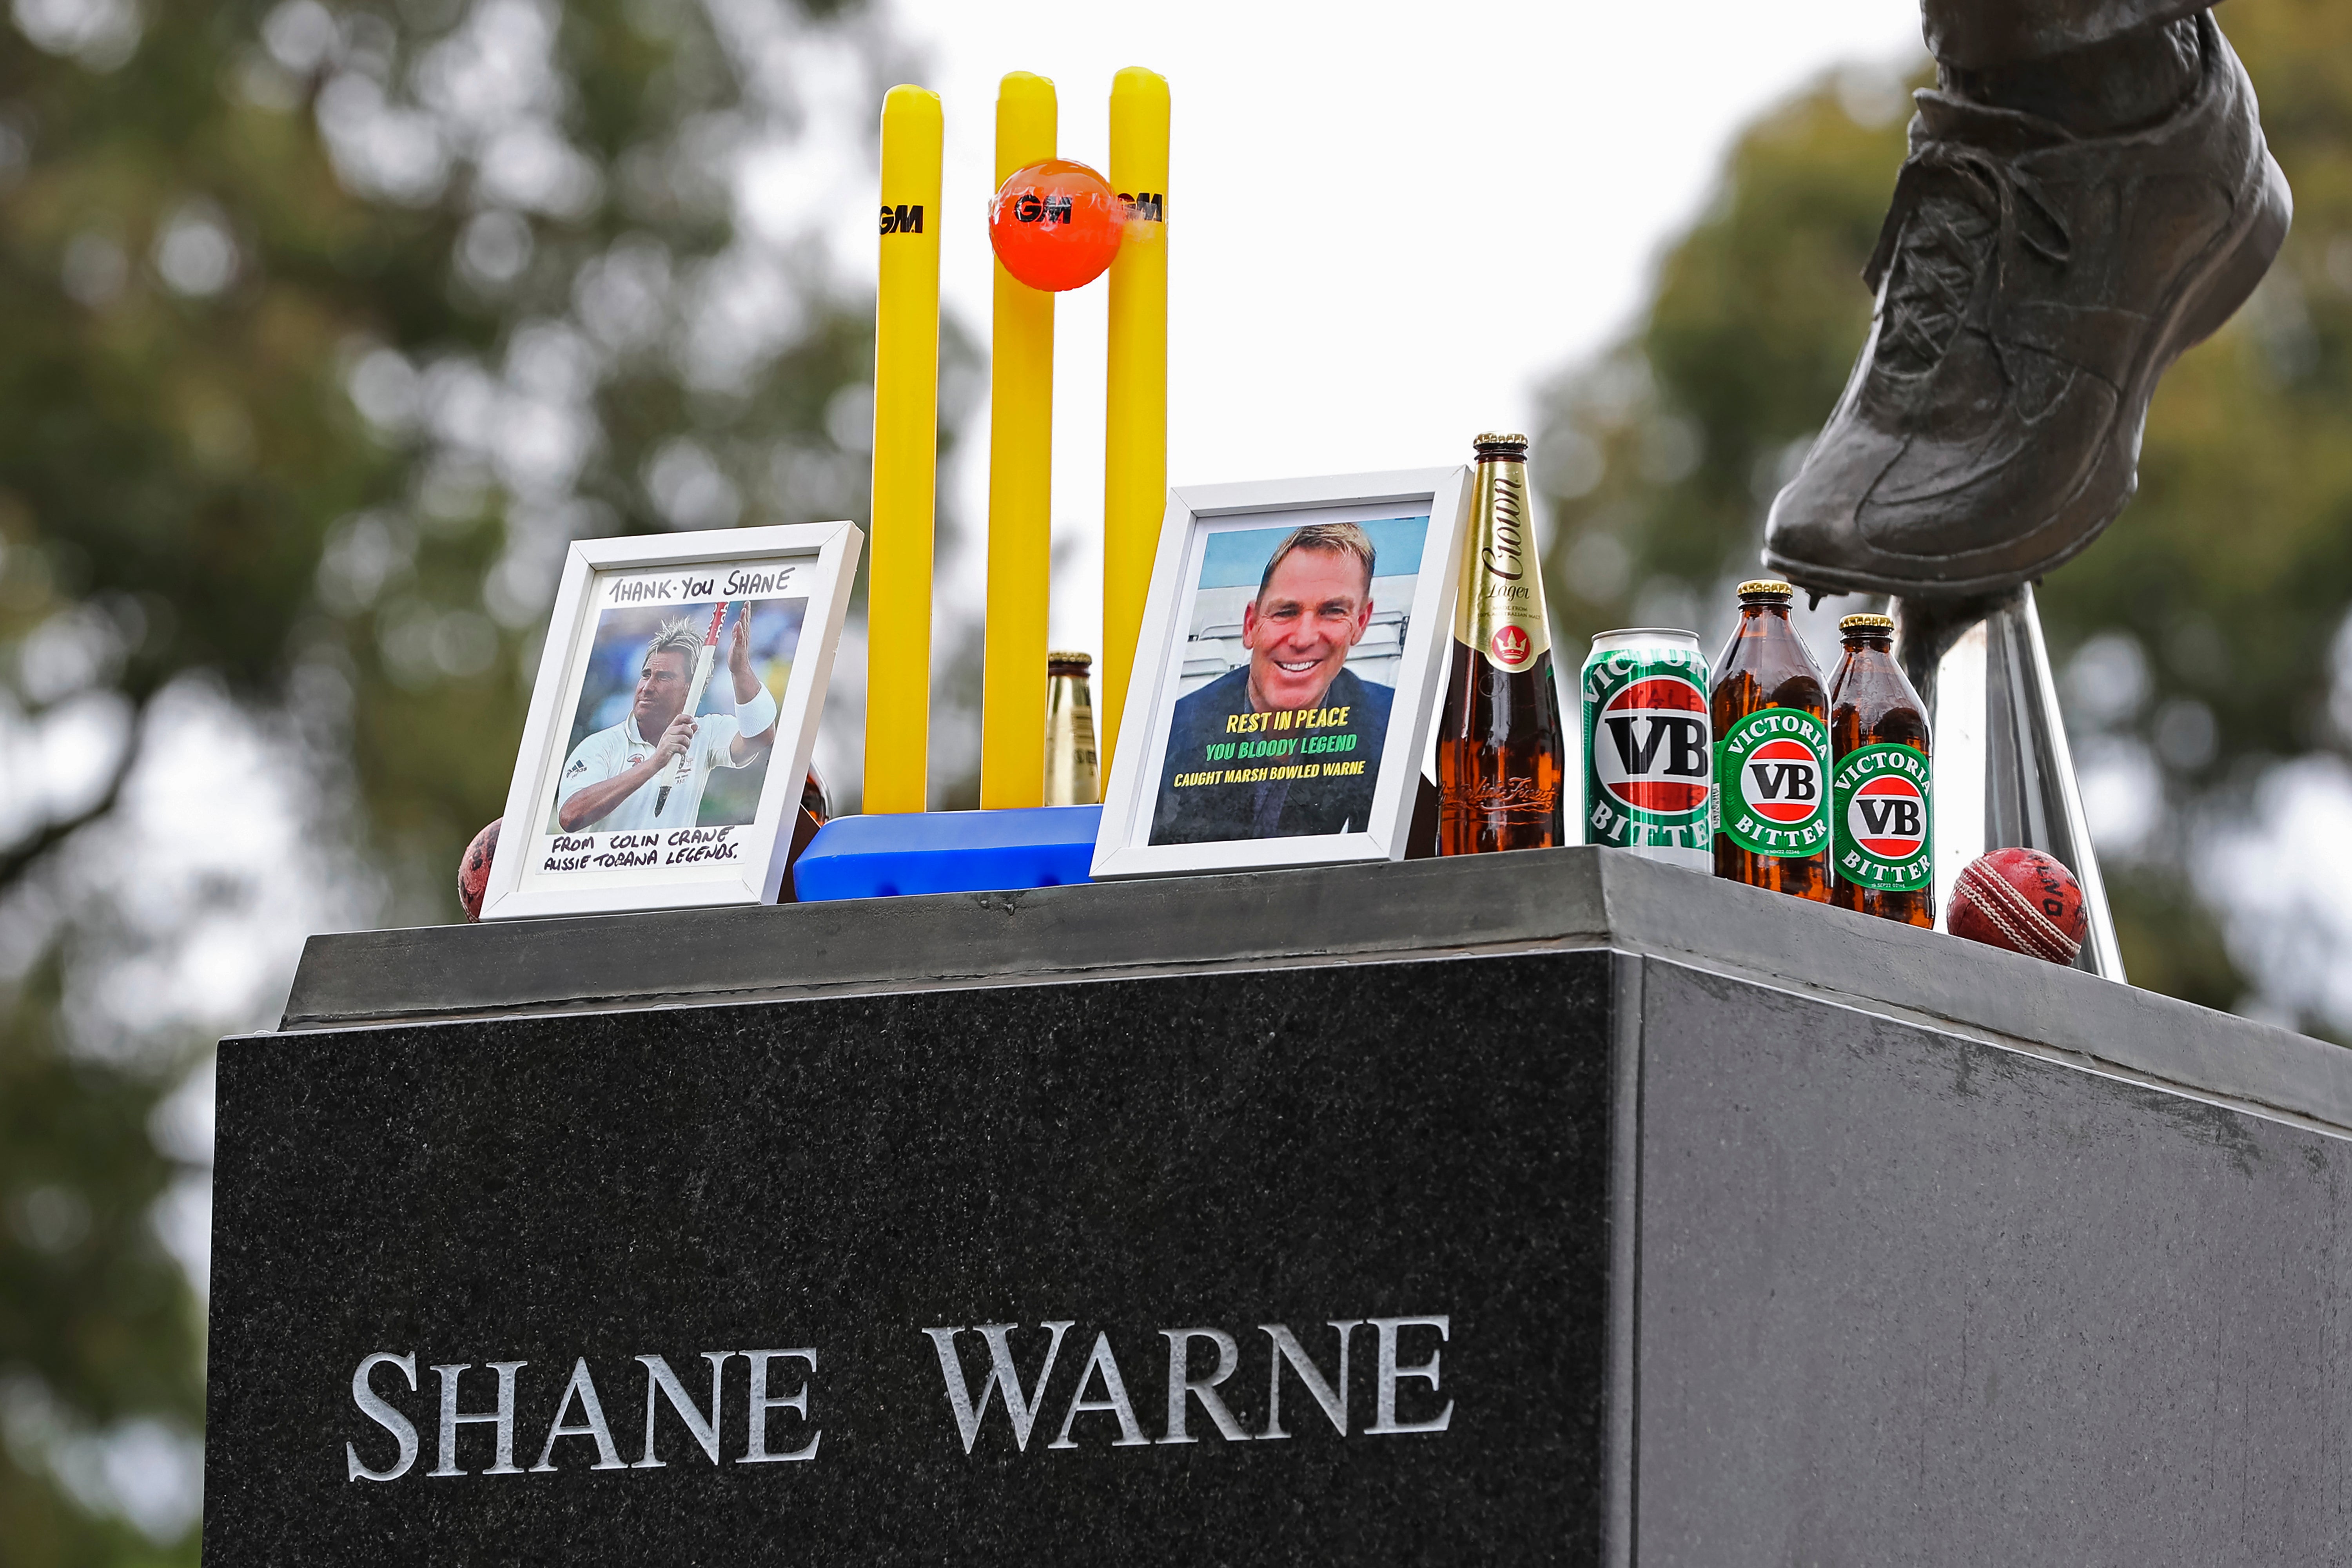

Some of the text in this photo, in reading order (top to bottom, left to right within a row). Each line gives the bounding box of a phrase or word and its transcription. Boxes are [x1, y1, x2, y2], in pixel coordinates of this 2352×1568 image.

[879, 205, 924, 235] GM
[1014, 194, 1072, 224] GM
[1482, 478, 1523, 580] Crown
[723, 566, 795, 596] SHANE
[1485, 582, 1530, 602] Lager
[1225, 706, 1350, 734] REST IN PEACE
[1206, 734, 1357, 761] YOU BLOODY LEGEND
[1604, 716, 1709, 778] VB
[1728, 715, 1828, 760] VICTORIA
[1173, 760, 1366, 787] CAUGHT MARSH BOWLED WARNE
[1749, 763, 1816, 801] VB
[1835, 752, 1931, 796] VICTORIA
[1590, 799, 1711, 847] BITTE
[1735, 814, 1828, 847] BITTER
[1856, 799, 1921, 836] VB
[552, 825, 735, 854] FROM COLIN CRANE
[543, 855, 592, 871] AUSSIE
[1842, 849, 1931, 882] BITTER
[346, 1315, 1455, 1482] SHANE WARNE
